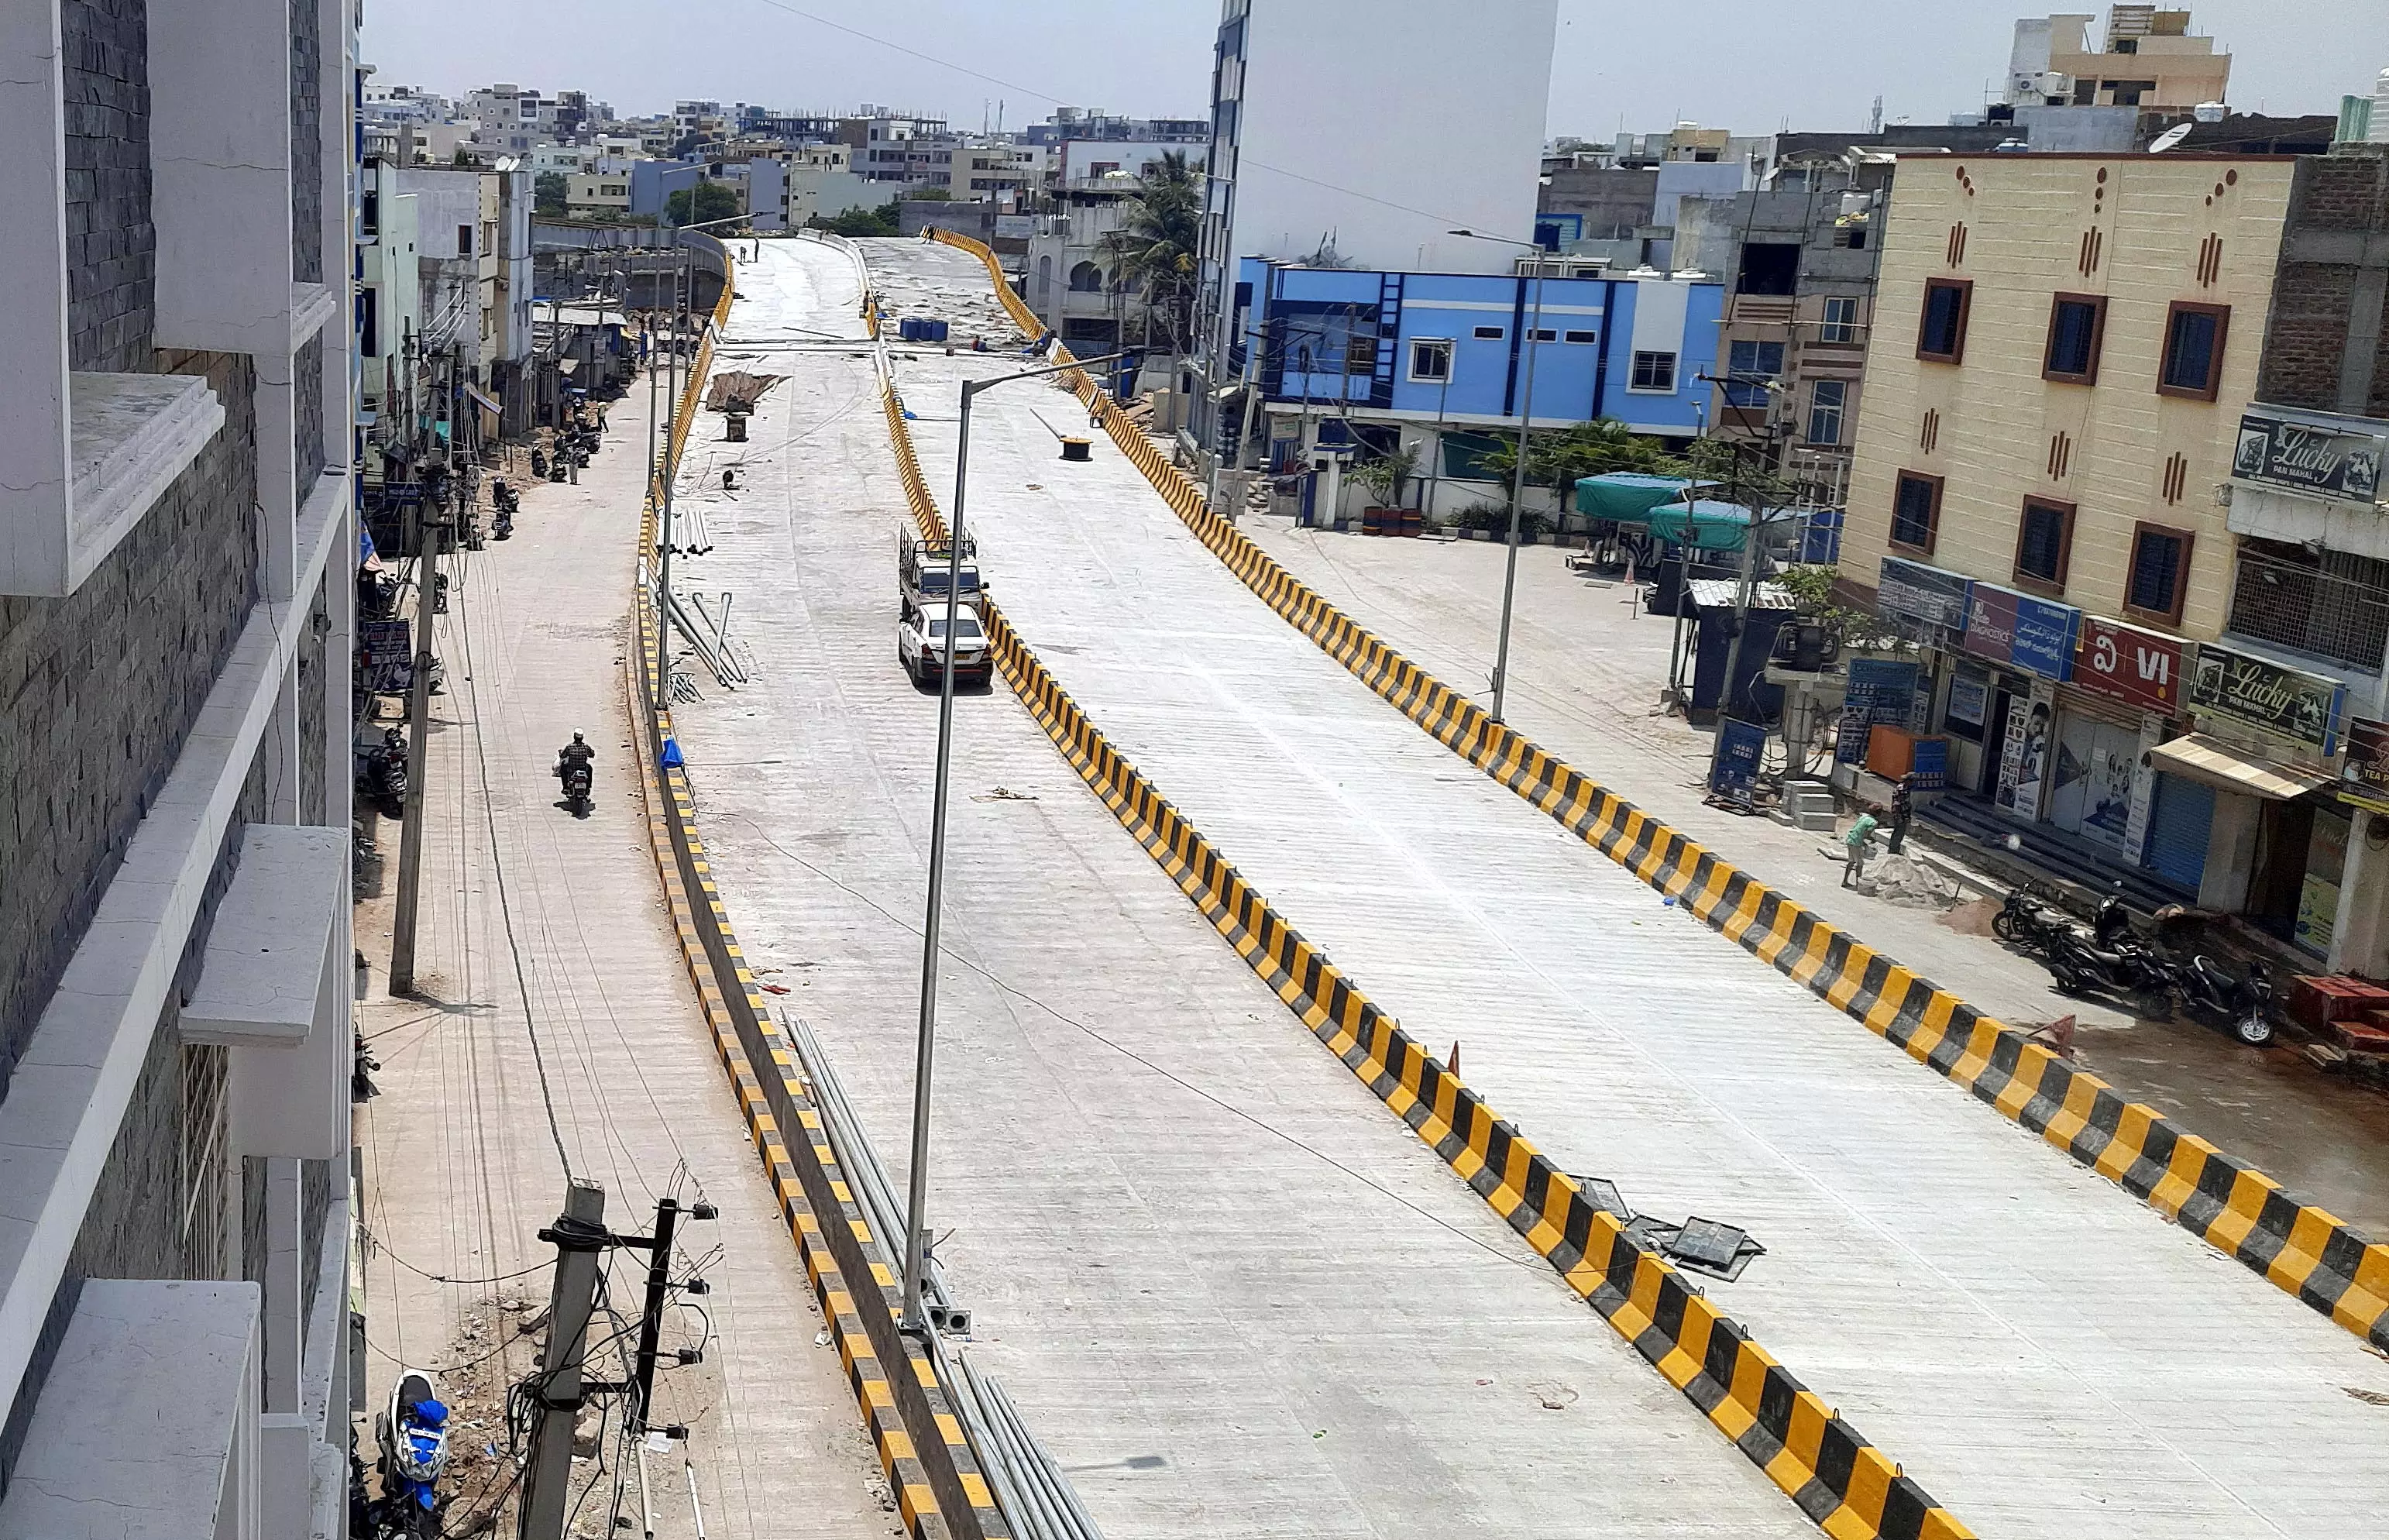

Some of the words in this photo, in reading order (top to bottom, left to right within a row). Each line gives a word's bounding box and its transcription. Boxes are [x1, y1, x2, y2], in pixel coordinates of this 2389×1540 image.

[2272, 430, 2341, 483] Lucky
[2228, 664, 2293, 720] Lucky
[2364, 768, 2380, 781] TEA
